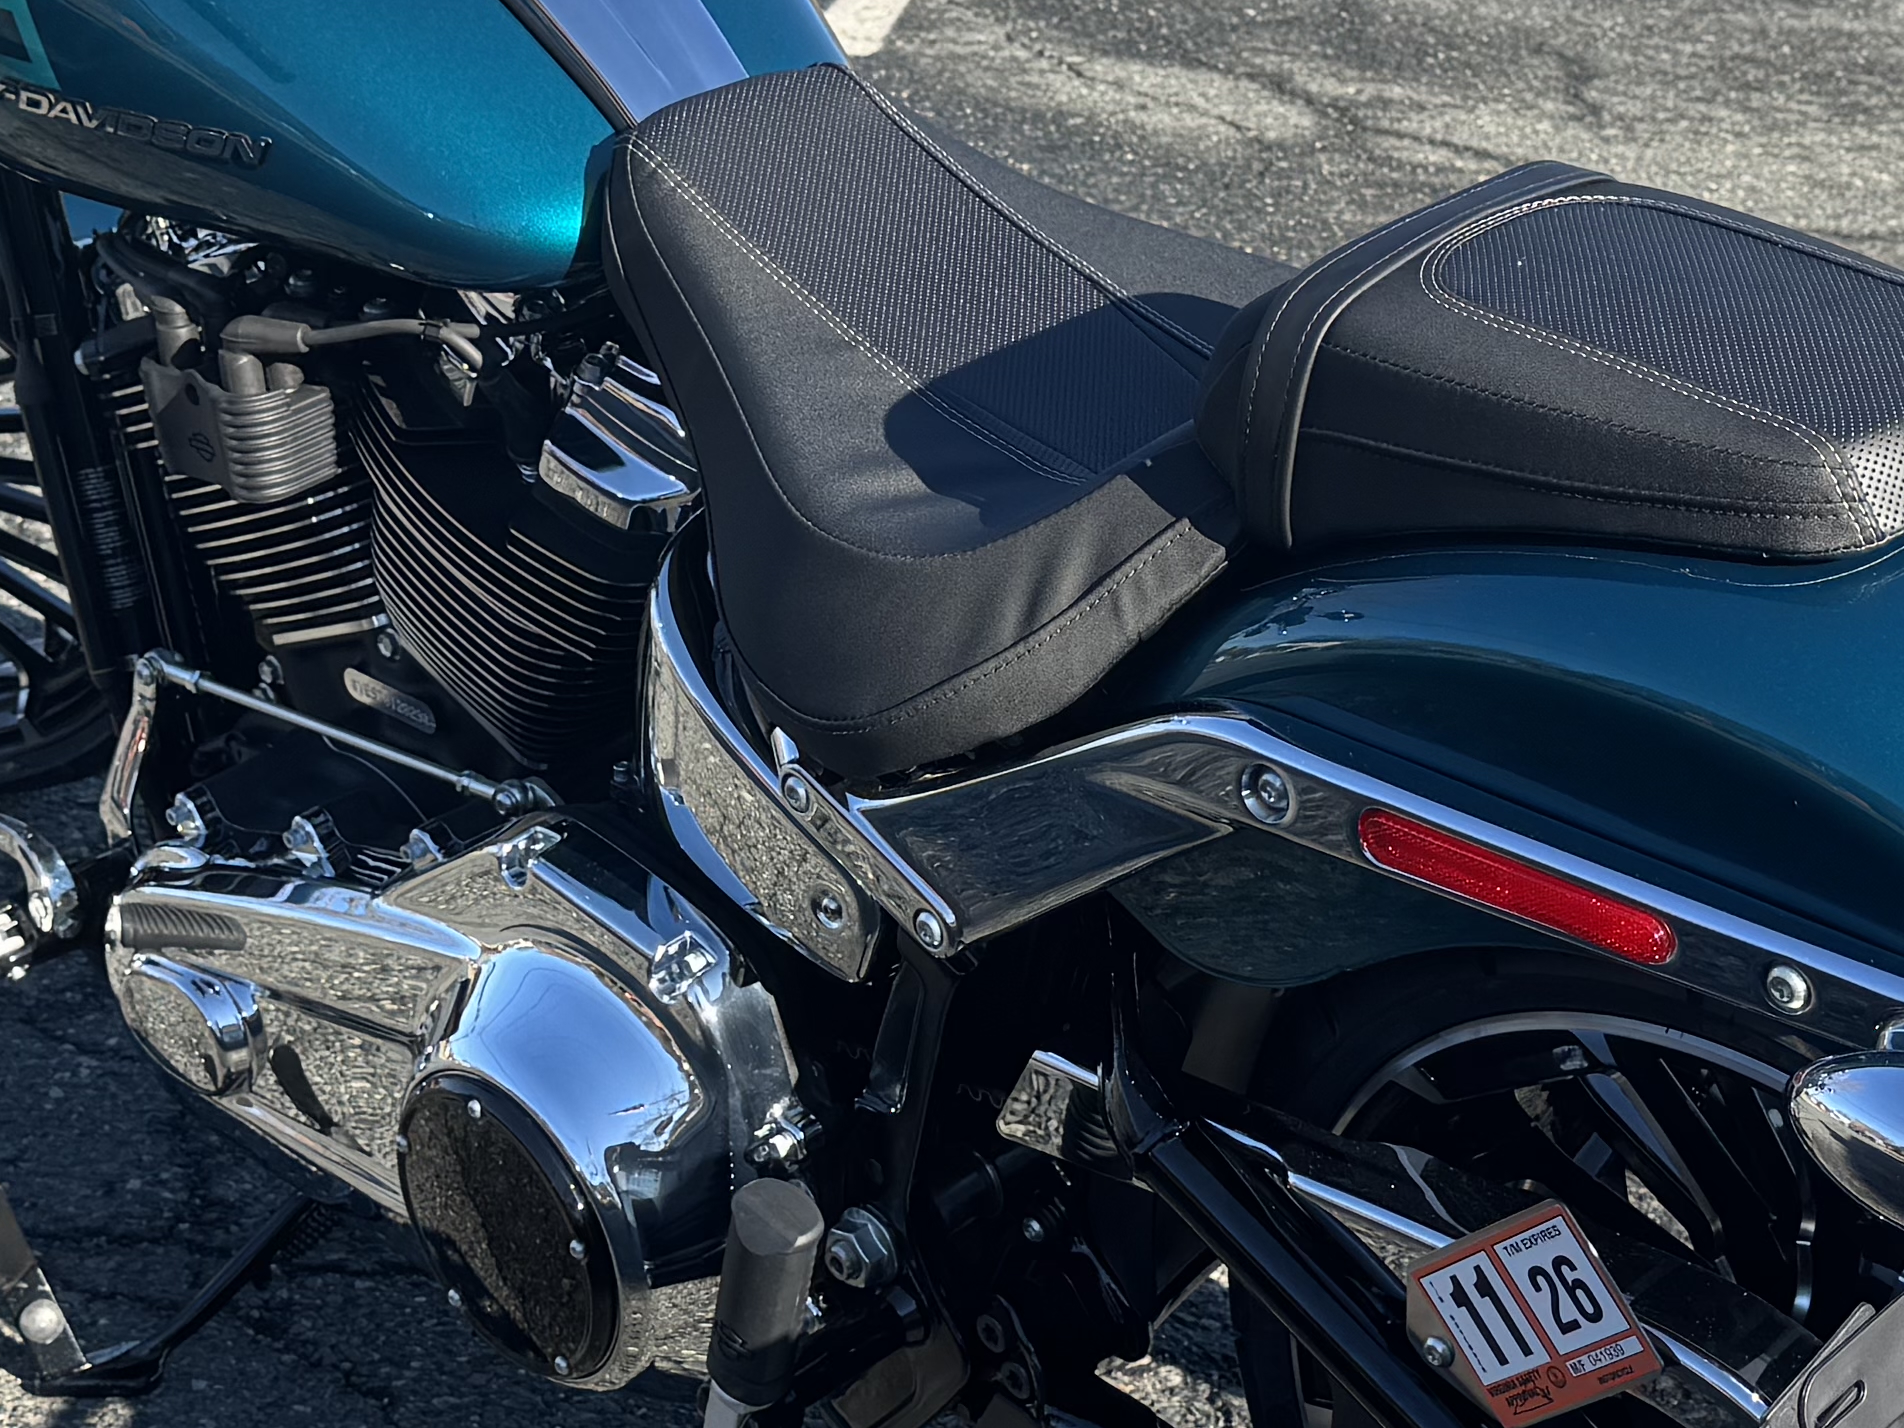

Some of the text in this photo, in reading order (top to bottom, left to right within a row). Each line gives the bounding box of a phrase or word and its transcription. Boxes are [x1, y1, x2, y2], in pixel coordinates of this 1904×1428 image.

[1520, 1225, 1562, 1250] EXPIRES
[1449, 1264, 1534, 1366] 11
[1528, 1255, 1604, 1336] 26
